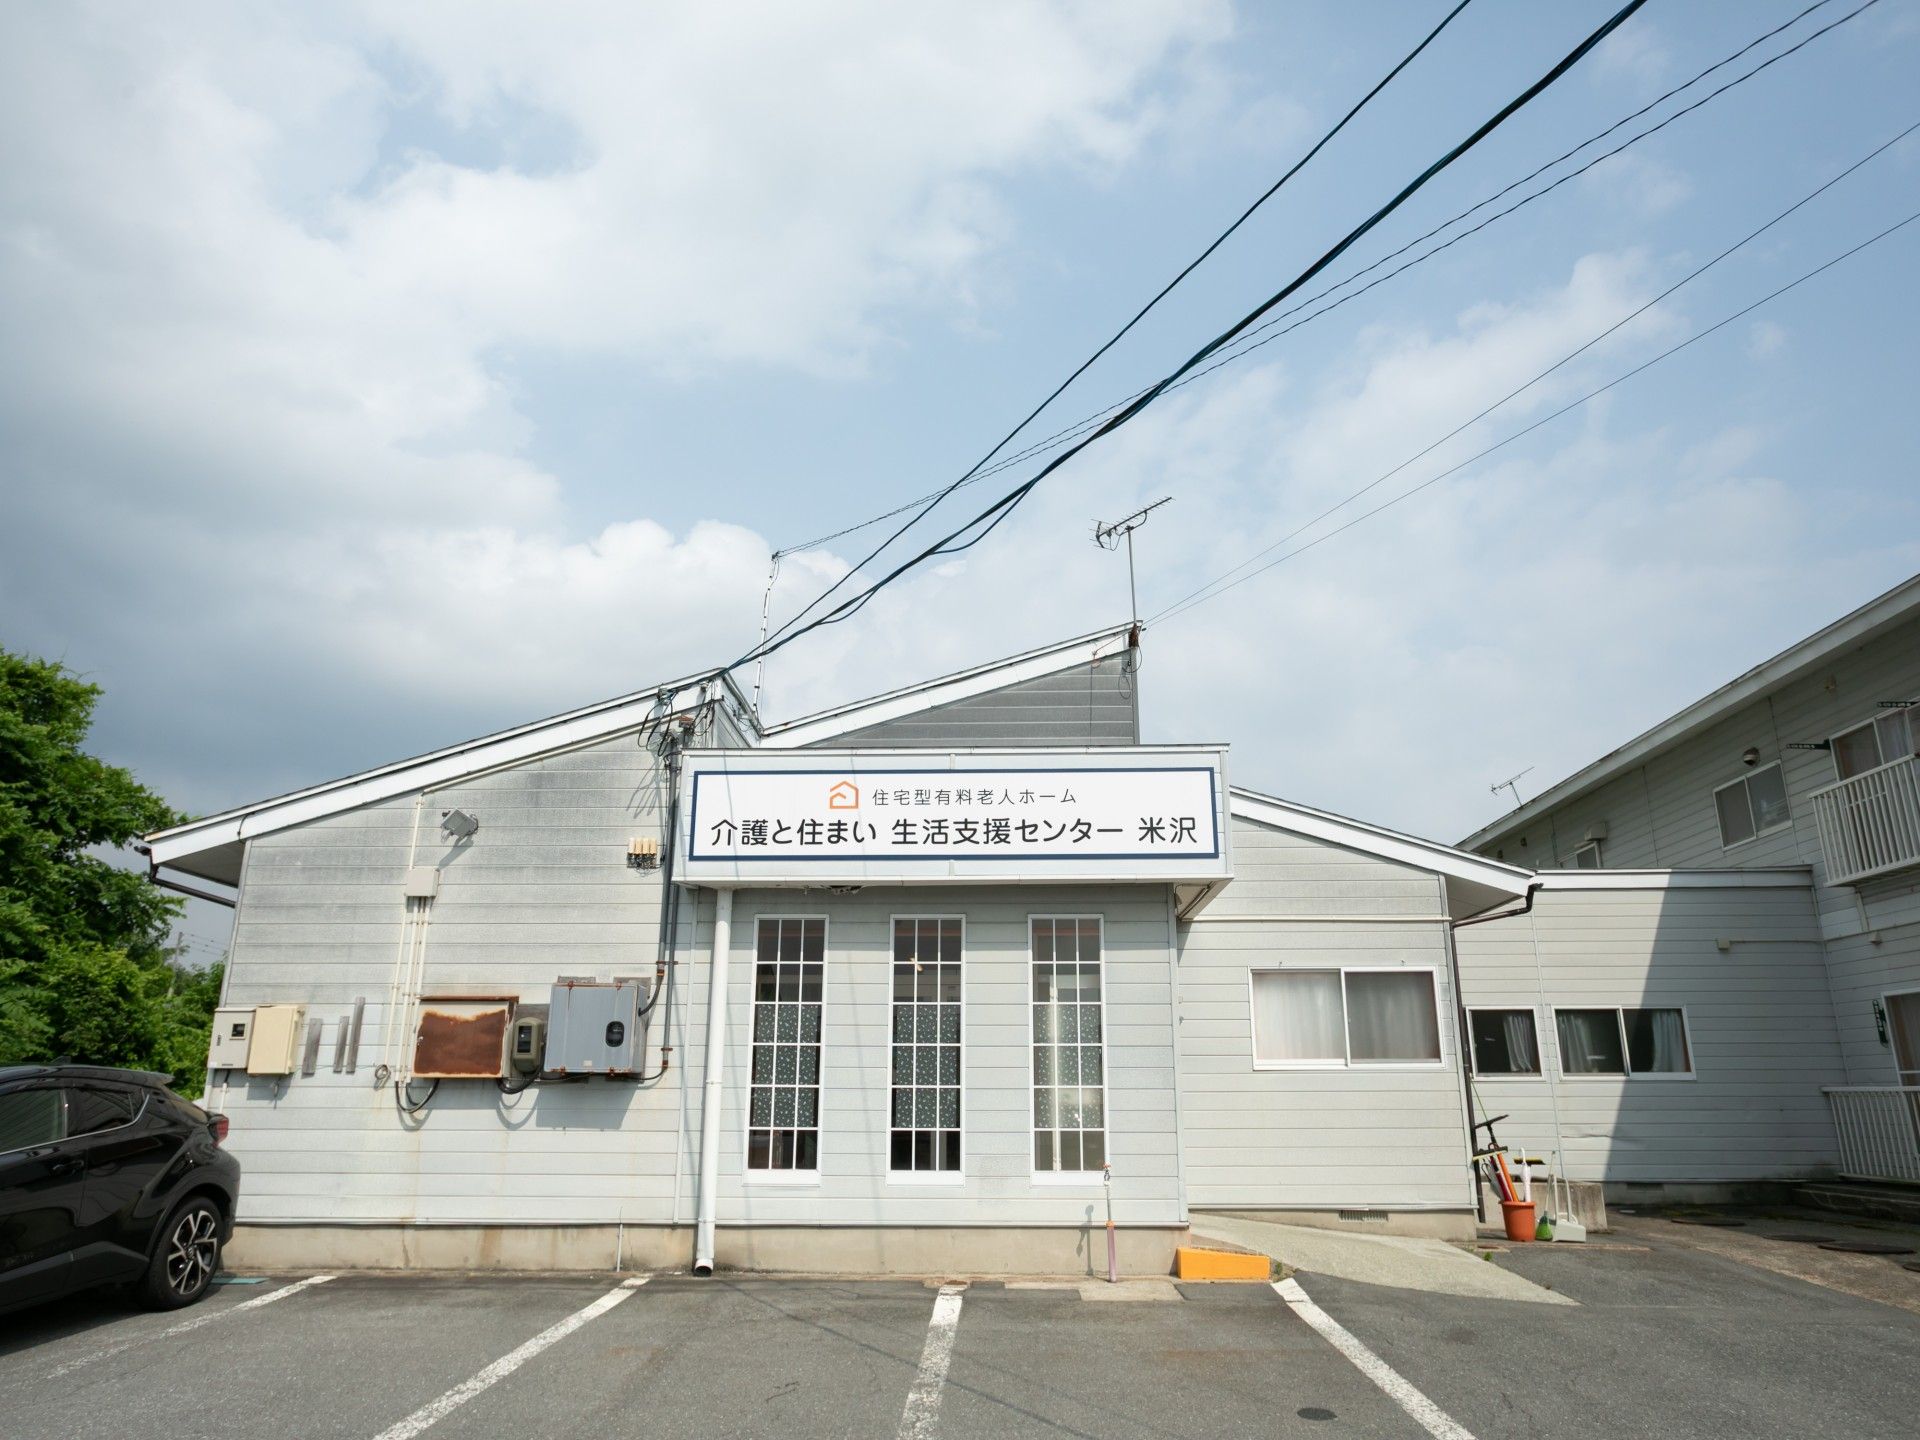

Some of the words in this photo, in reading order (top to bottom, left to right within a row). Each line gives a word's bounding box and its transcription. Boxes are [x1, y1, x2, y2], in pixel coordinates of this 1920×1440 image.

[872, 788, 1076, 806] 住宅型有料老人ホーム
[711, 818, 877, 846] 介護と住まい
[891, 817, 1123, 845] 生活支援センター
[1138, 816, 1198, 844] 米沢
